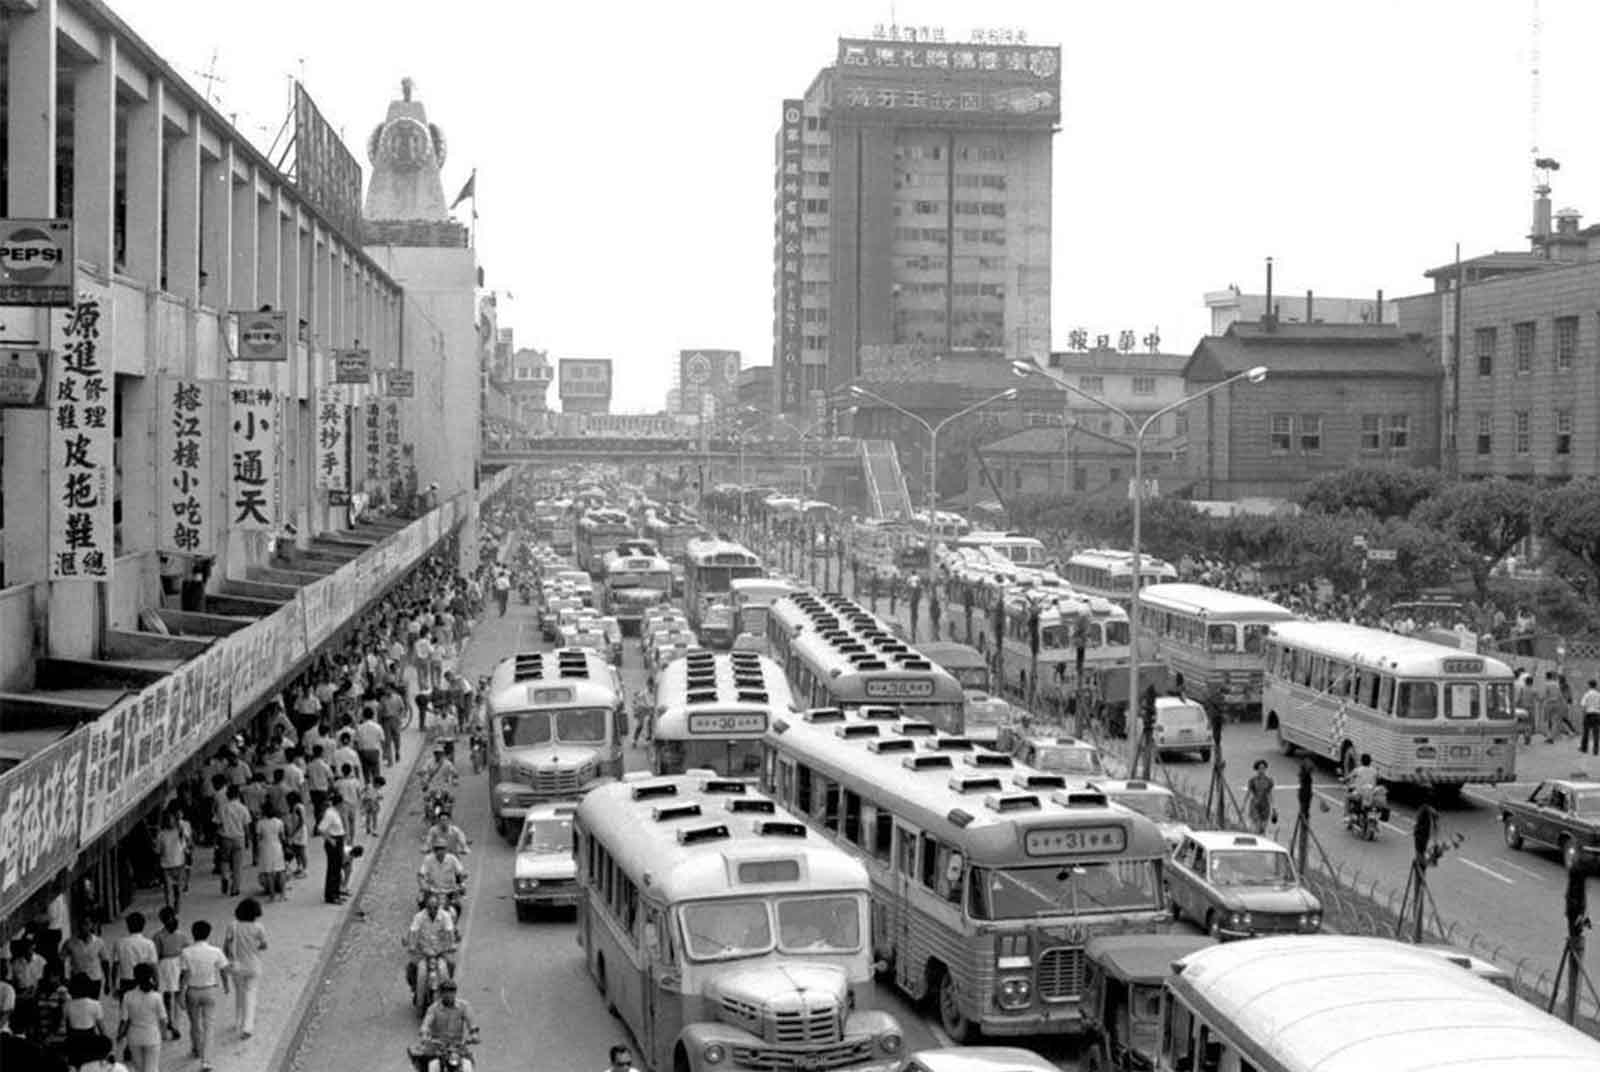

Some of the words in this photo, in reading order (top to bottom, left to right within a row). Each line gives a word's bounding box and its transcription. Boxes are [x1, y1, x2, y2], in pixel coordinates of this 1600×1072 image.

[62, 302, 101, 376] 源進
[62, 433, 98, 551] 皮拖鞋
[233, 411, 271, 525] 小通天
[1066, 832, 1086, 849] 31
